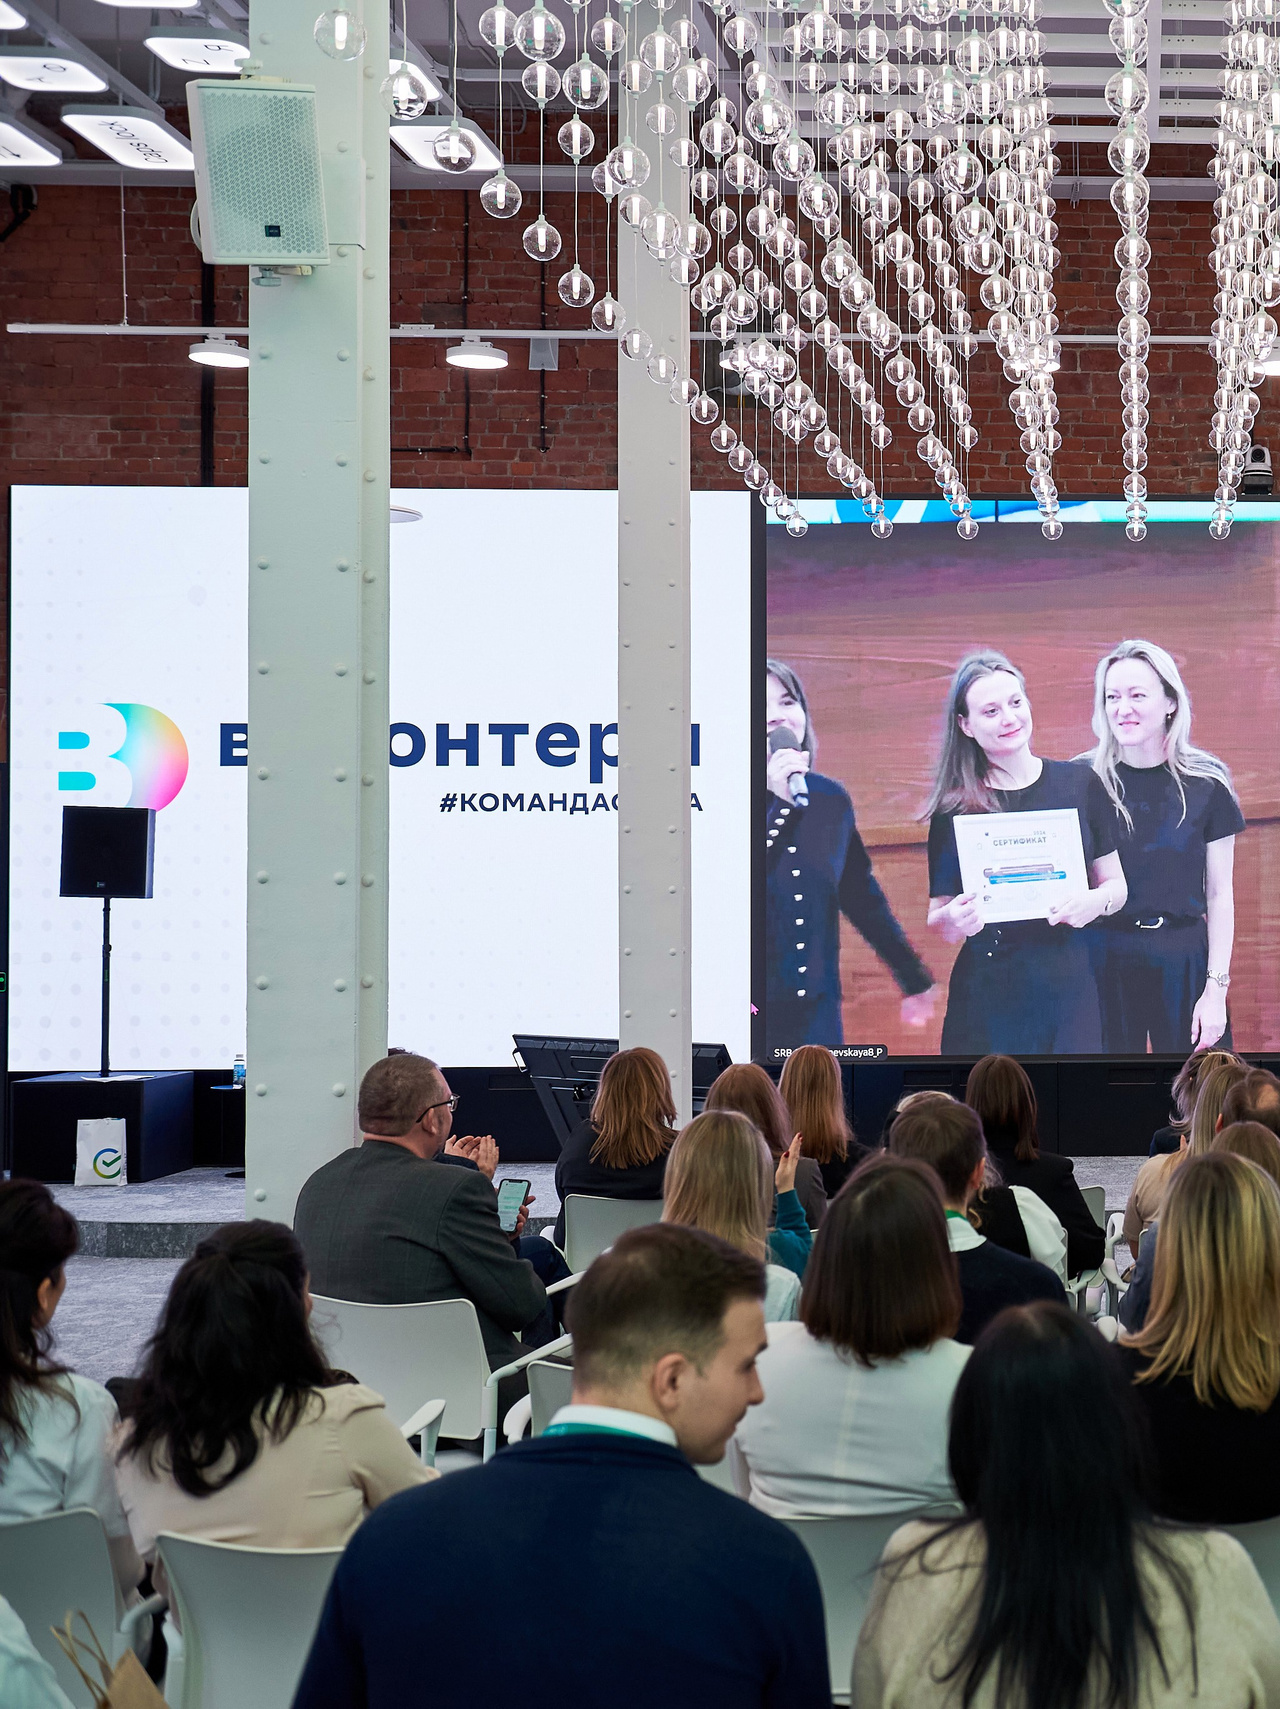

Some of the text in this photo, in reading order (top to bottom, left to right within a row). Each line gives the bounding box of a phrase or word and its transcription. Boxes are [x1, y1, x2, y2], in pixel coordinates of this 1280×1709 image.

[220, 722, 700, 784] вонтер
[439, 793, 703, 814] #КОМАНДАА
[993, 837, 1046, 846] СЕРТИФИКАТ
